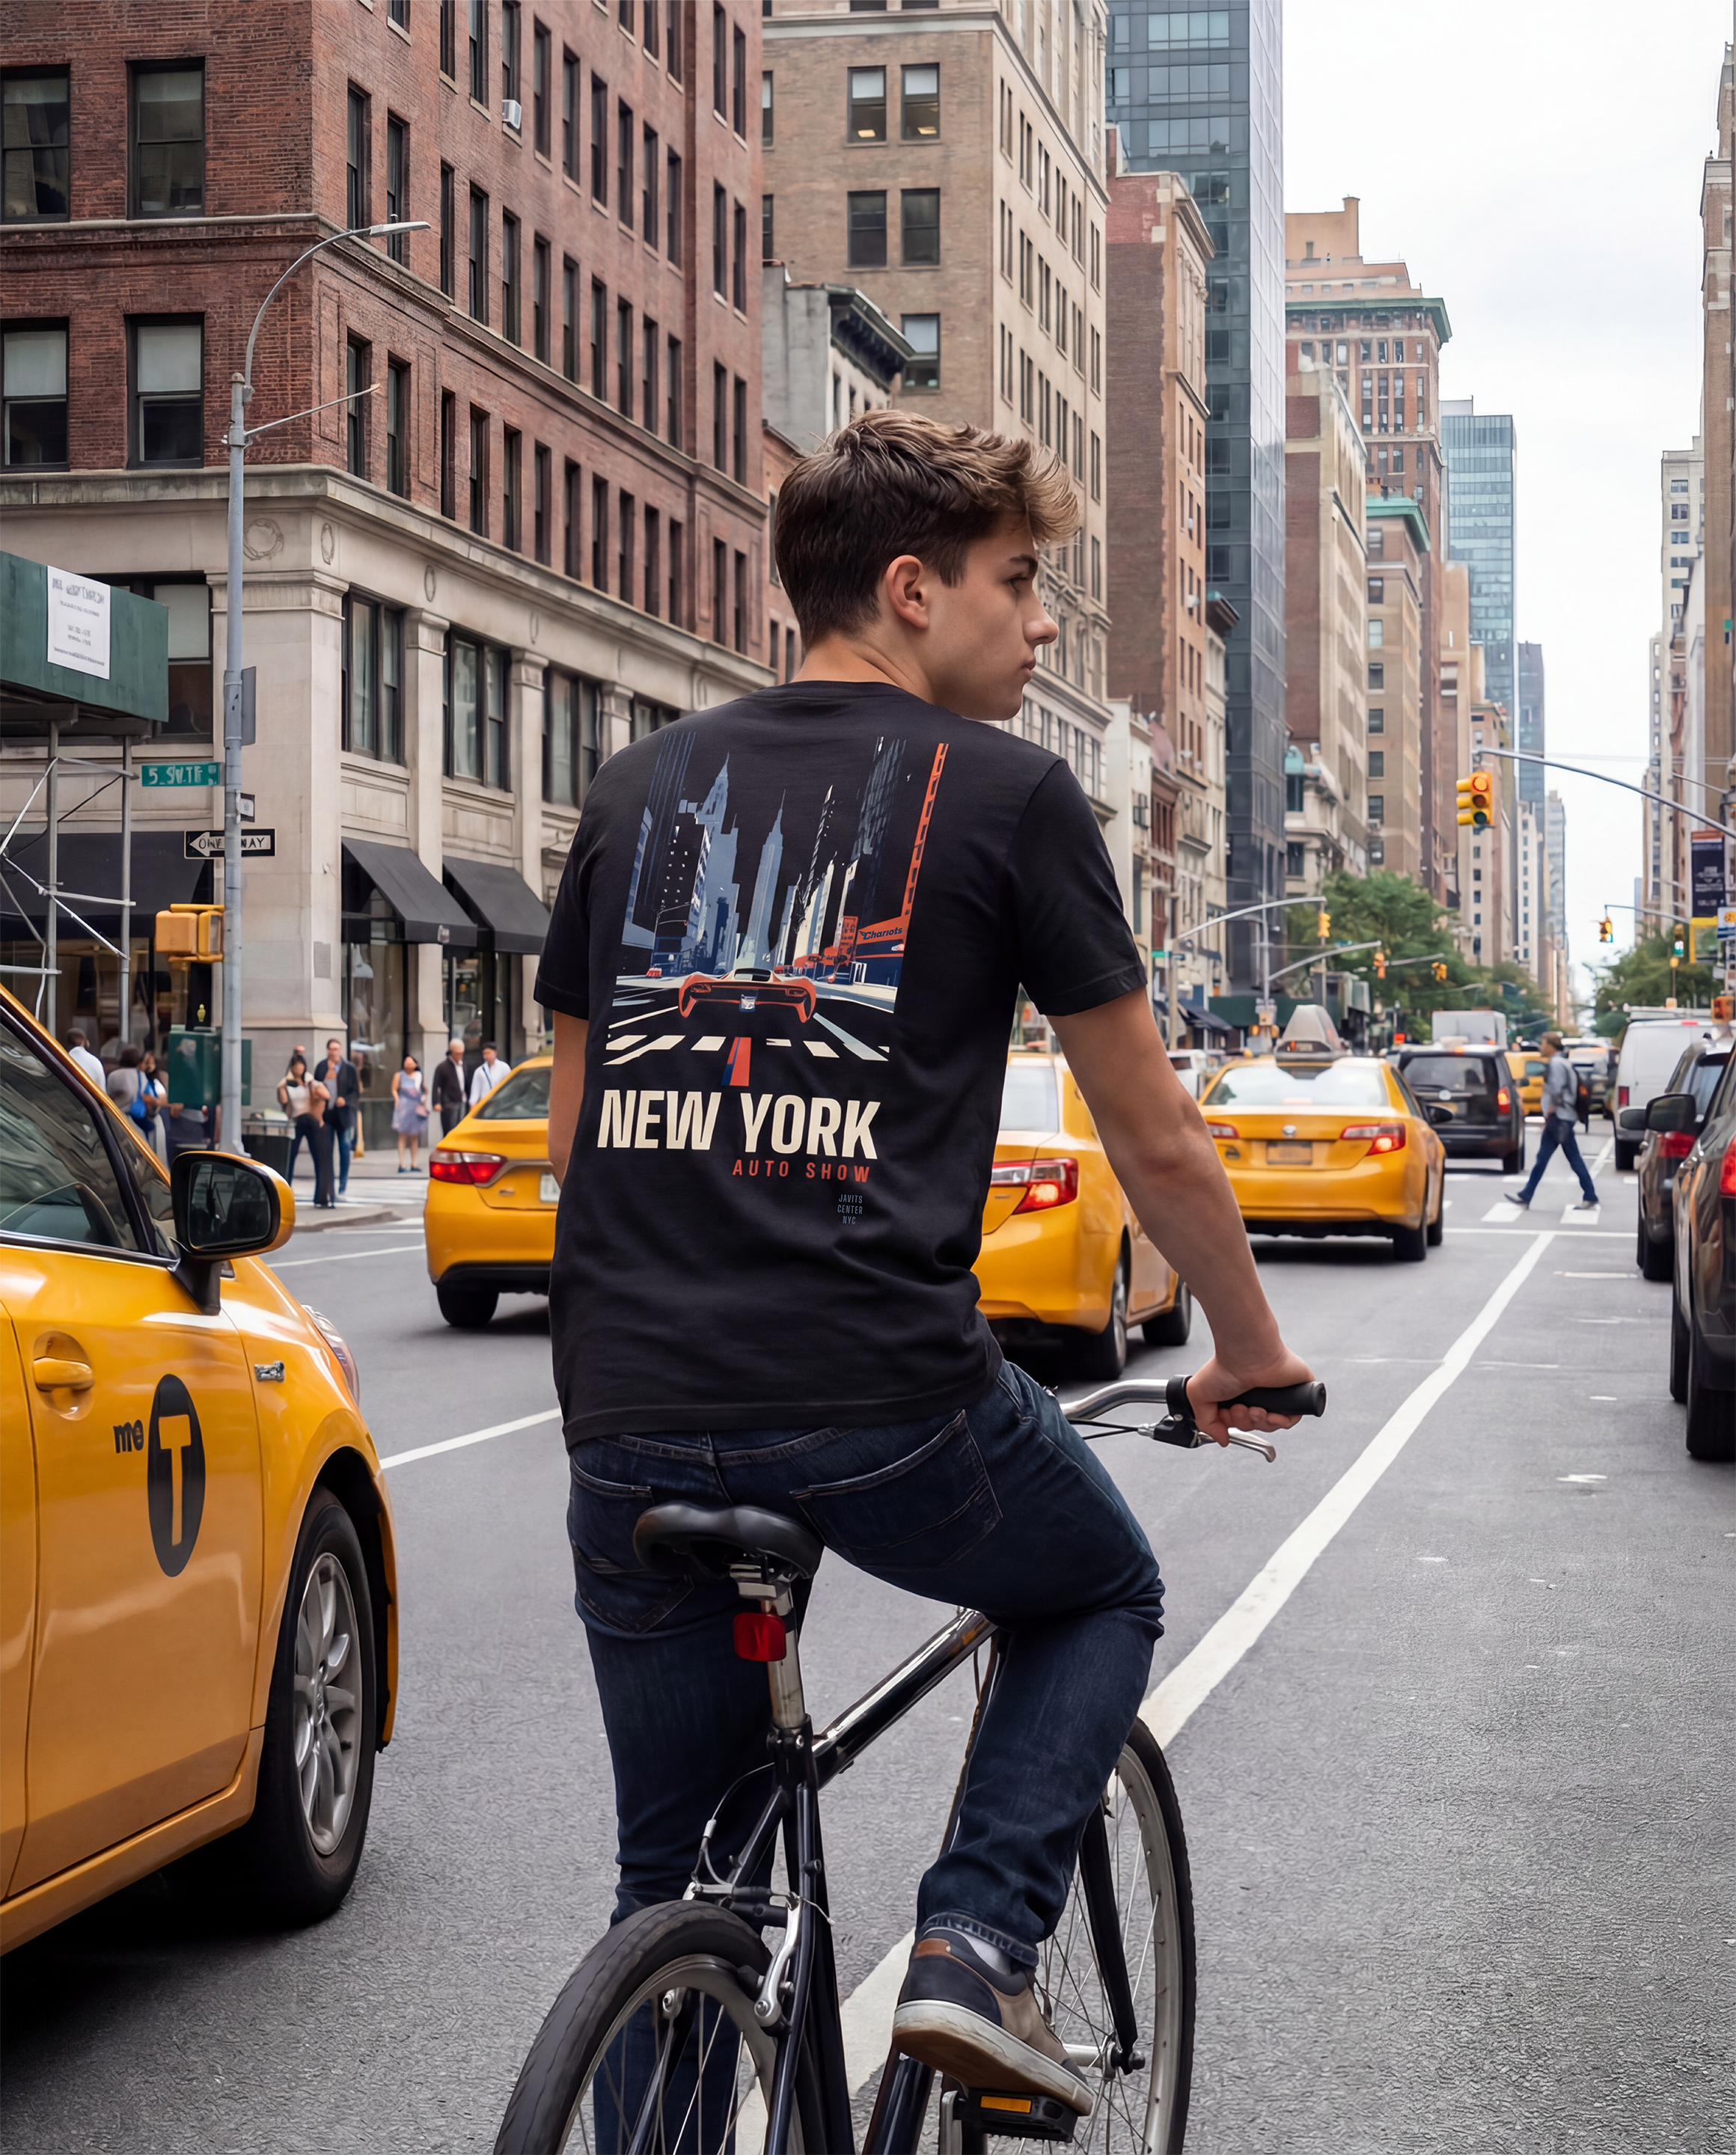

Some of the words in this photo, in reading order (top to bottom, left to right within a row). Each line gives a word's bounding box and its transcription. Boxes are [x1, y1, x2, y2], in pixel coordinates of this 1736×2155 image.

[859, 926, 903, 941] Chariots
[597, 1089, 722, 1150] NEW
[740, 1092, 881, 1159] YORK
[732, 1159, 789, 1177] AUTO
[805, 1161, 870, 1183] SHOW
[838, 1193, 863, 1204] JAVITS
[837, 1204, 864, 1214] CENTER
[842, 1215, 856, 1225] NYC
[158, 1413, 192, 1547] T
